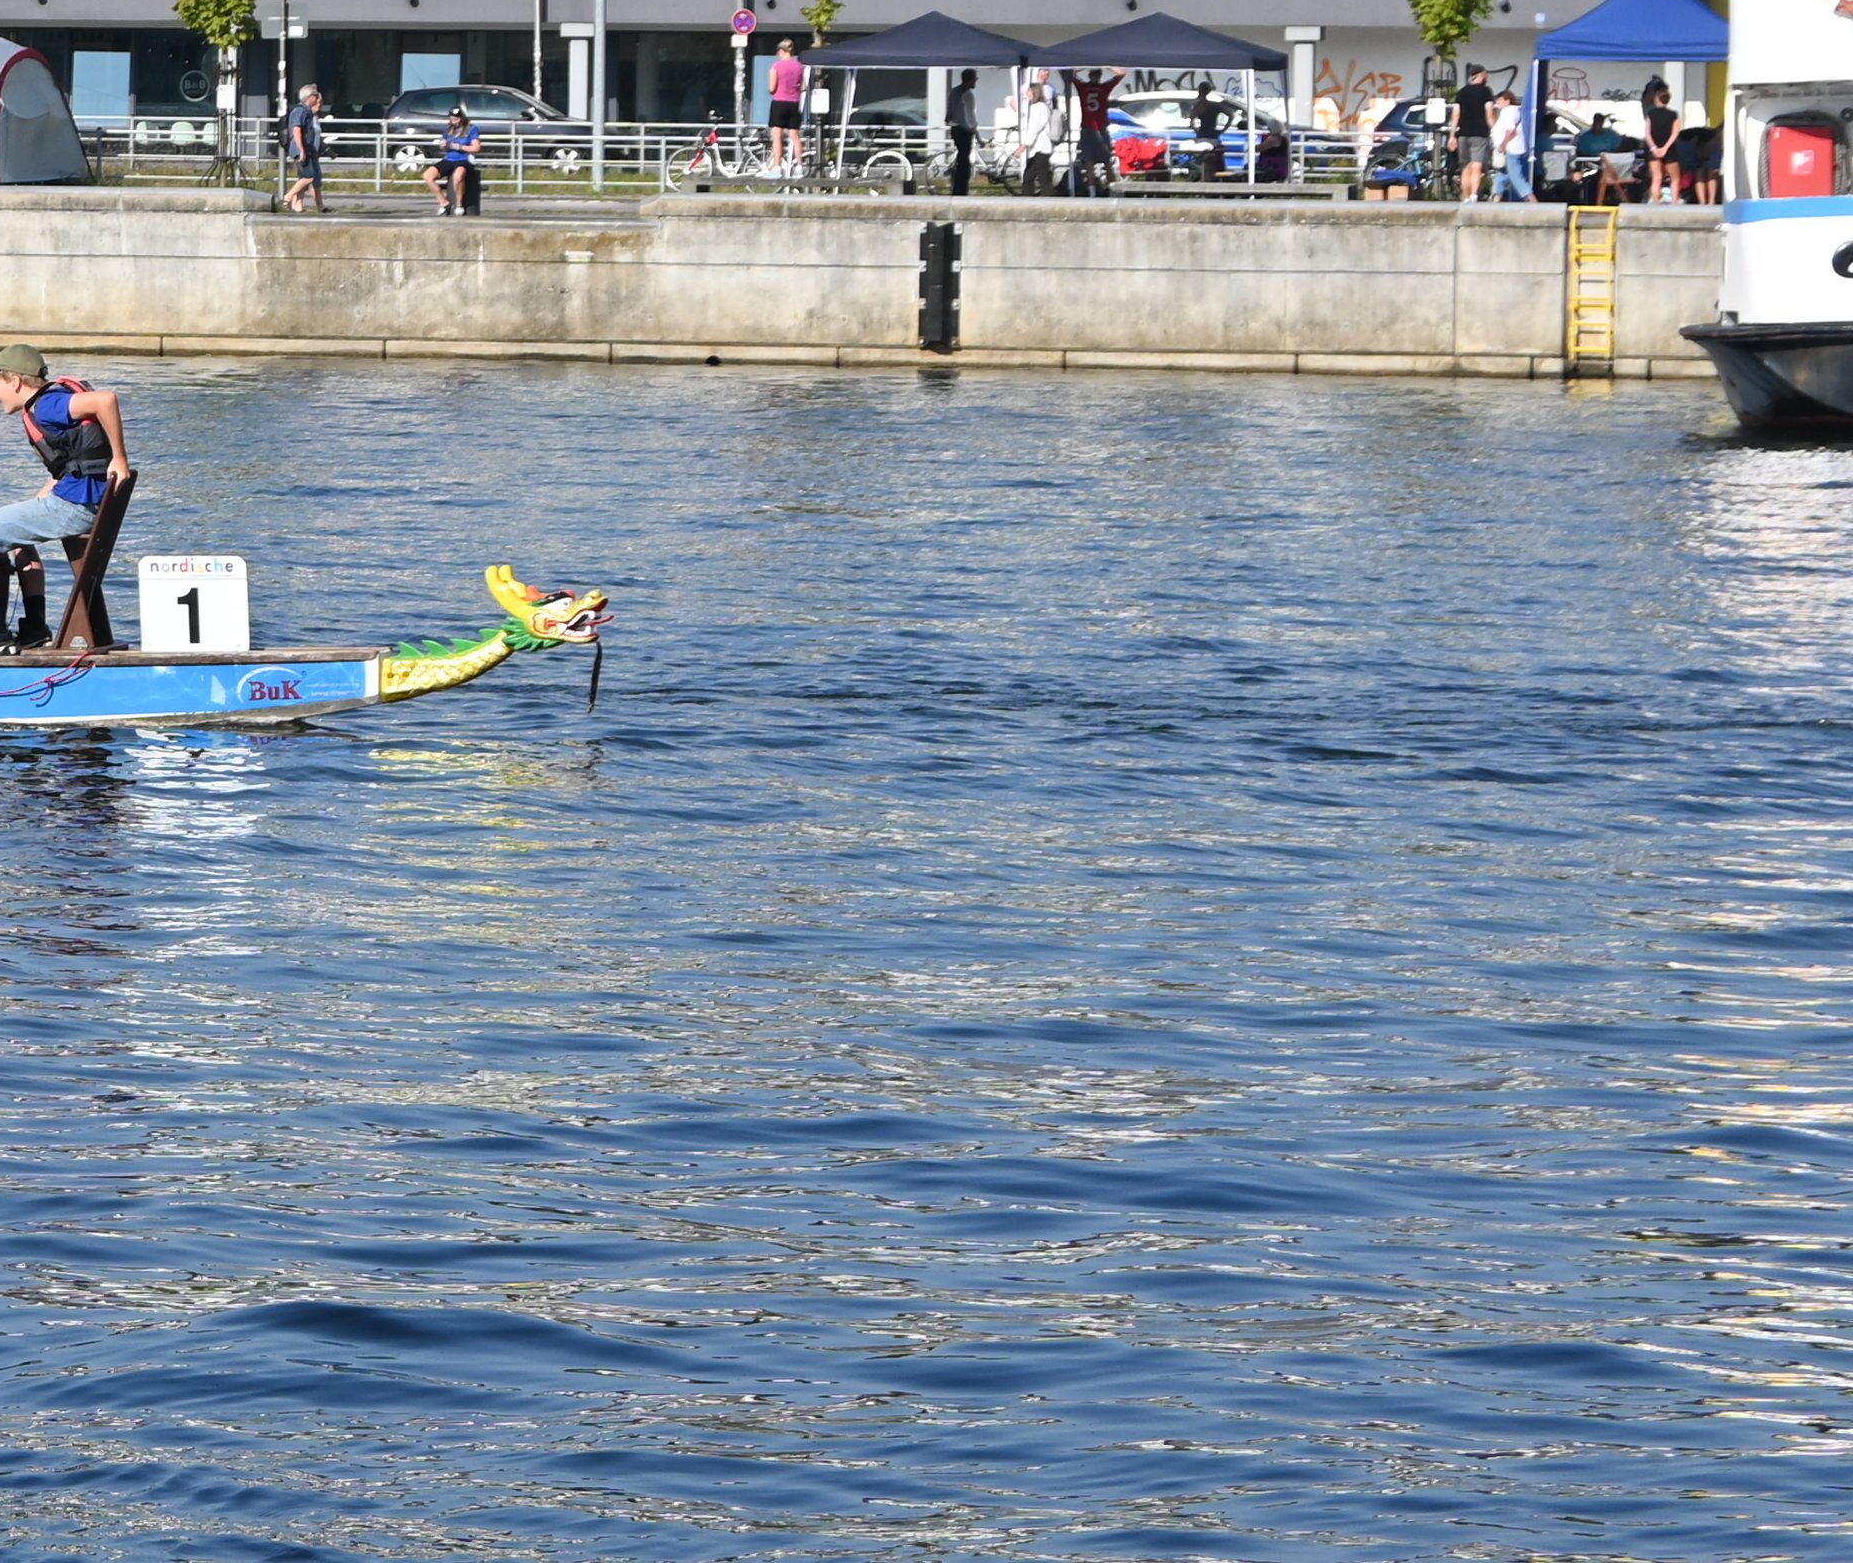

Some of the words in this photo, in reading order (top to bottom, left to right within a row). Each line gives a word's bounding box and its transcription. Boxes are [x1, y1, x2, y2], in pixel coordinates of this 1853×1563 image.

[1087, 93, 1100, 112] 5
[150, 557, 234, 573] nordische
[177, 586, 201, 644] 1
[248, 679, 302, 702] BuK
